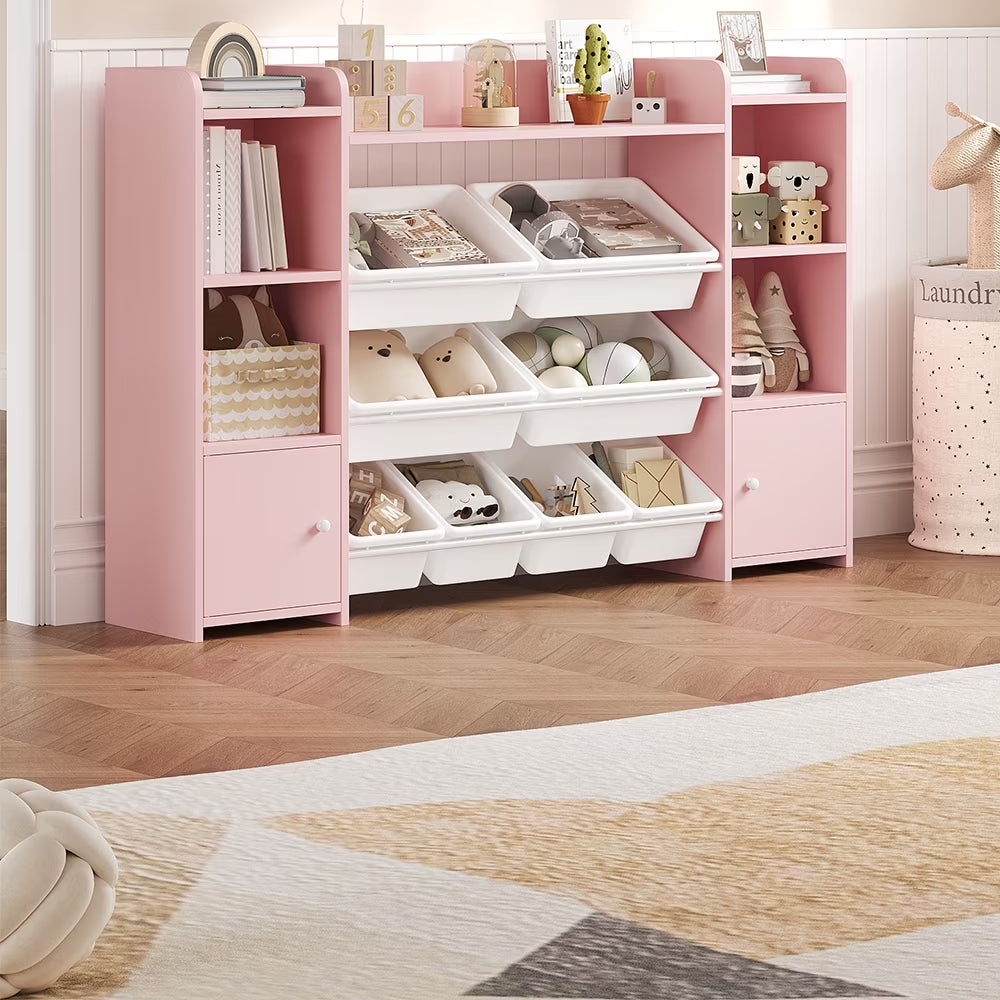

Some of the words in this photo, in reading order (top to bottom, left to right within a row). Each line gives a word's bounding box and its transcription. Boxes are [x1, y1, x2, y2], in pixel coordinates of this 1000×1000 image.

[361, 28, 375, 57] 1
[558, 40, 573, 50] art
[361, 100, 381, 129] 5
[398, 99, 416, 127] 6
